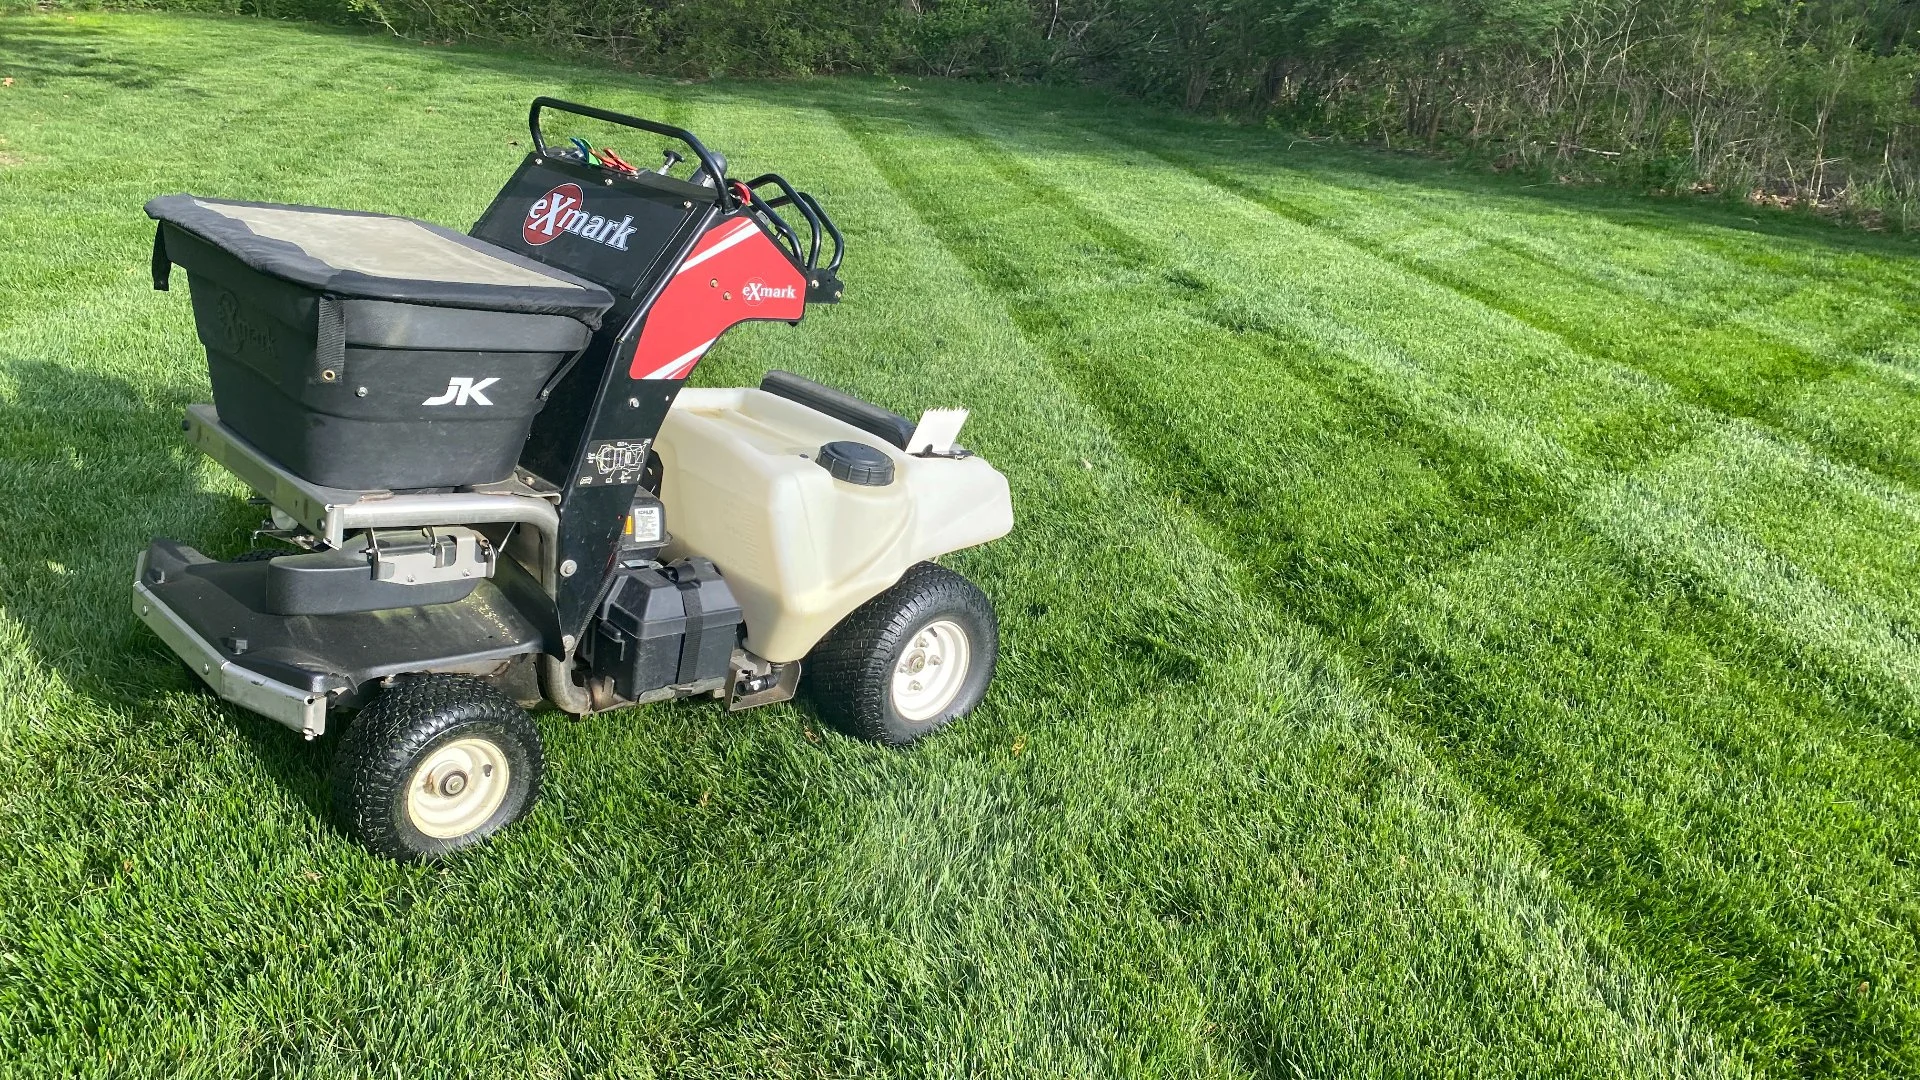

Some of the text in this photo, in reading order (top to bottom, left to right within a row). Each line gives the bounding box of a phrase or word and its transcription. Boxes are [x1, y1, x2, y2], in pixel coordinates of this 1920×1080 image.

[528, 192, 638, 252] eXmark
[742, 282, 797, 301] eXmark
[422, 376, 501, 406] JK
